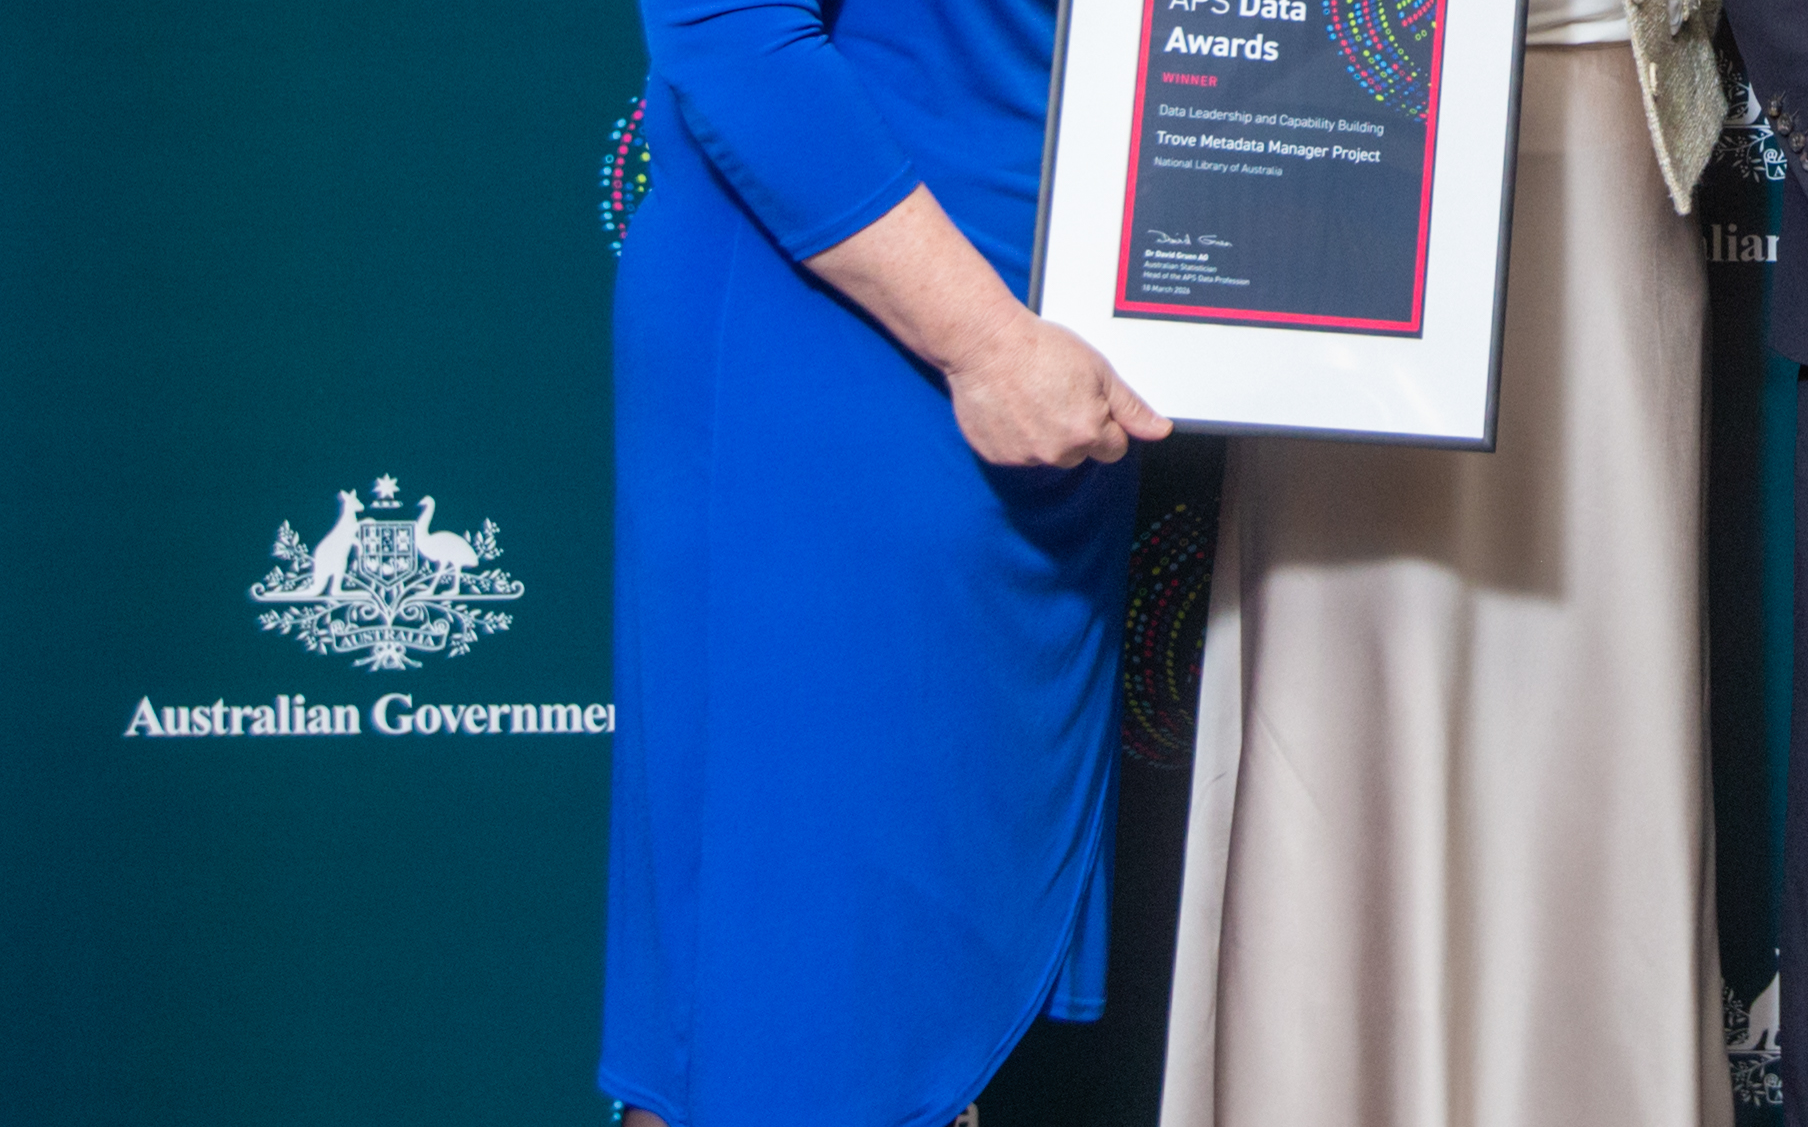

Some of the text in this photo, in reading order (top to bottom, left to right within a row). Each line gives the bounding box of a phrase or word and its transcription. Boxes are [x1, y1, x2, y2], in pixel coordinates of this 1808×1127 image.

[1163, 26, 1280, 61] Awards
[1162, 72, 1218, 87] WINNER
[1159, 104, 1385, 137] Data Leadership and Capability Building
[1156, 130, 1381, 164] Trove Metadata Manager Project
[1154, 156, 1283, 176] National Library of Australia
[1144, 249, 1154, 257] Dr
[1155, 250, 1176, 259] David
[1176, 251, 1198, 260] Gruen
[1144, 261, 1179, 270] Australian
[1152, 285, 1173, 293] March
[340, 630, 435, 648] AUSTRALIA
[124, 693, 616, 736] Australian Governme
